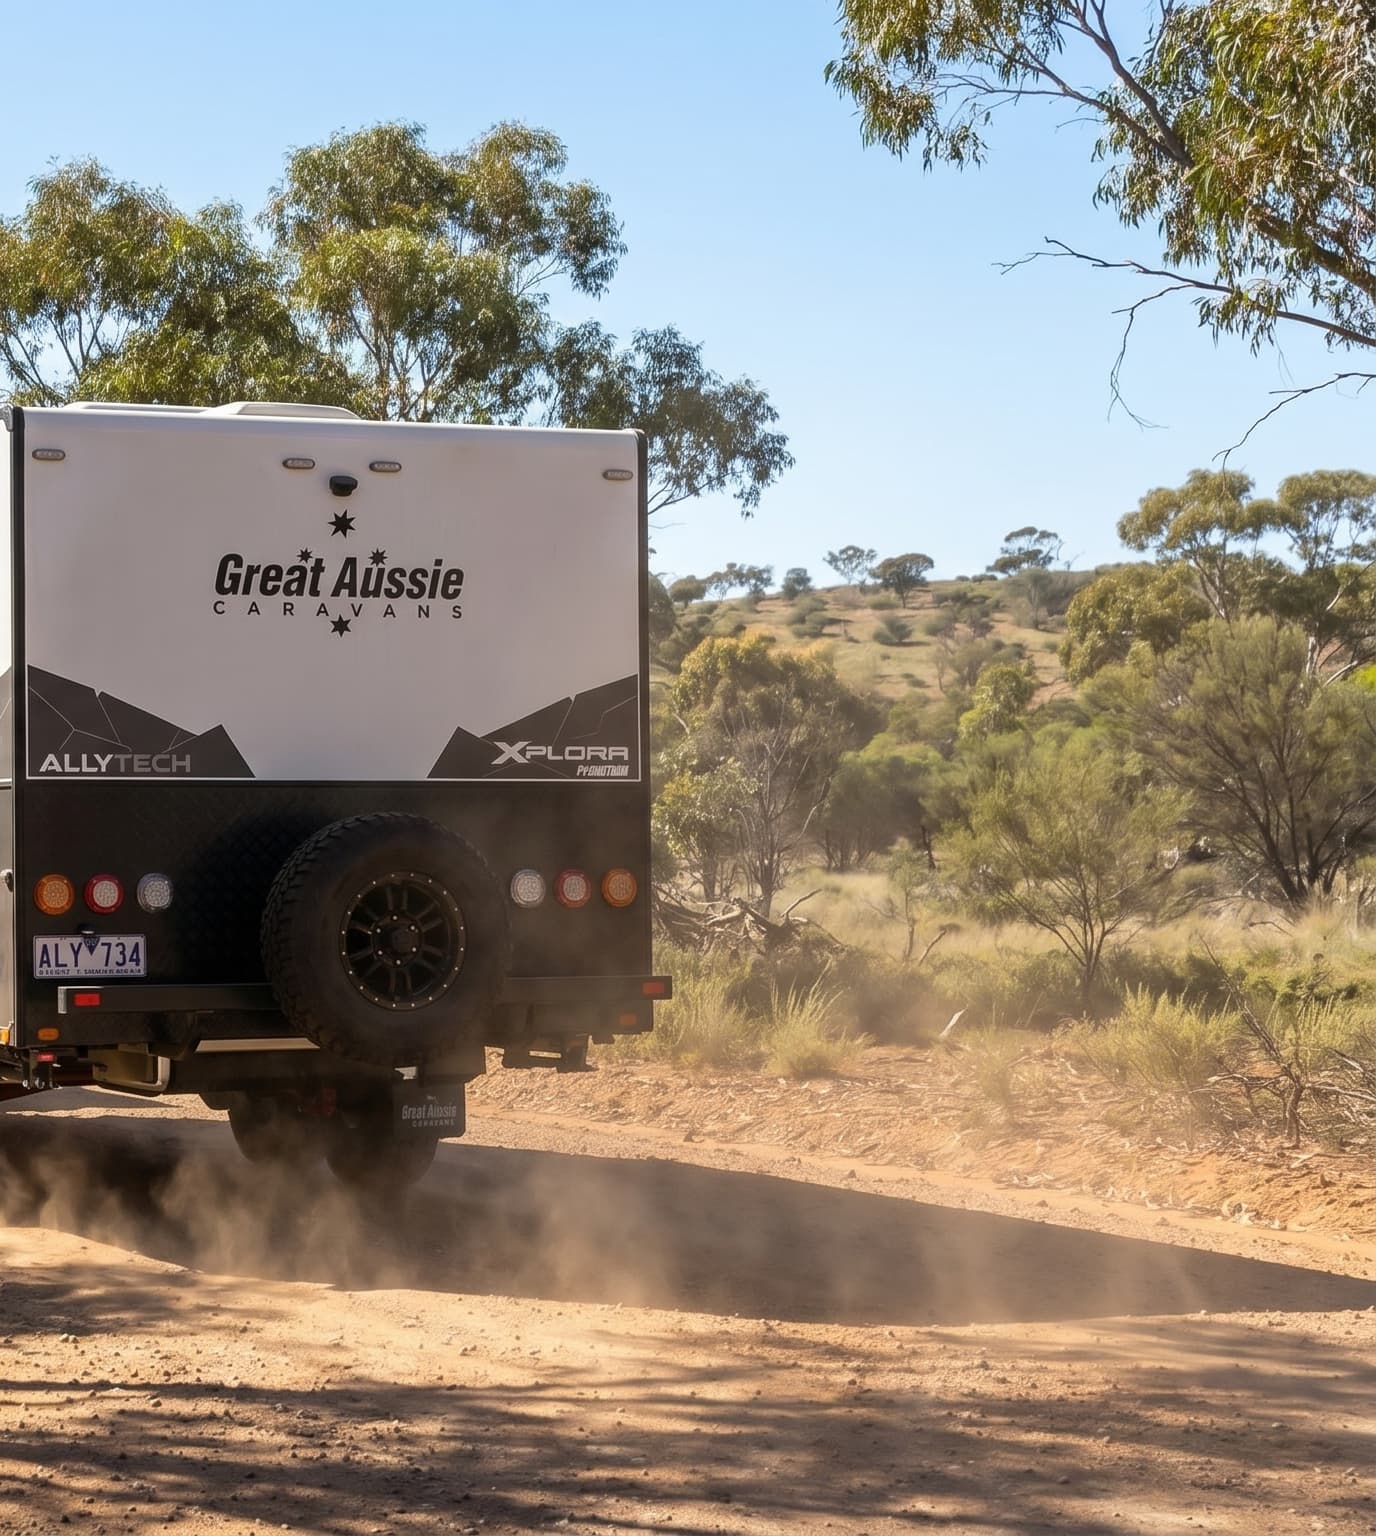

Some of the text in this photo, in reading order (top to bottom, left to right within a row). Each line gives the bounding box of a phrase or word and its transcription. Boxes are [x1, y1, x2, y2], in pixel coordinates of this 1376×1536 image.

[214, 553, 465, 600] Great Aussie
[213, 600, 463, 619] CARAVANS
[39, 753, 191, 773] ALLYTECH
[490, 741, 629, 765] XPLORA
[39, 941, 142, 968] ALY 734
